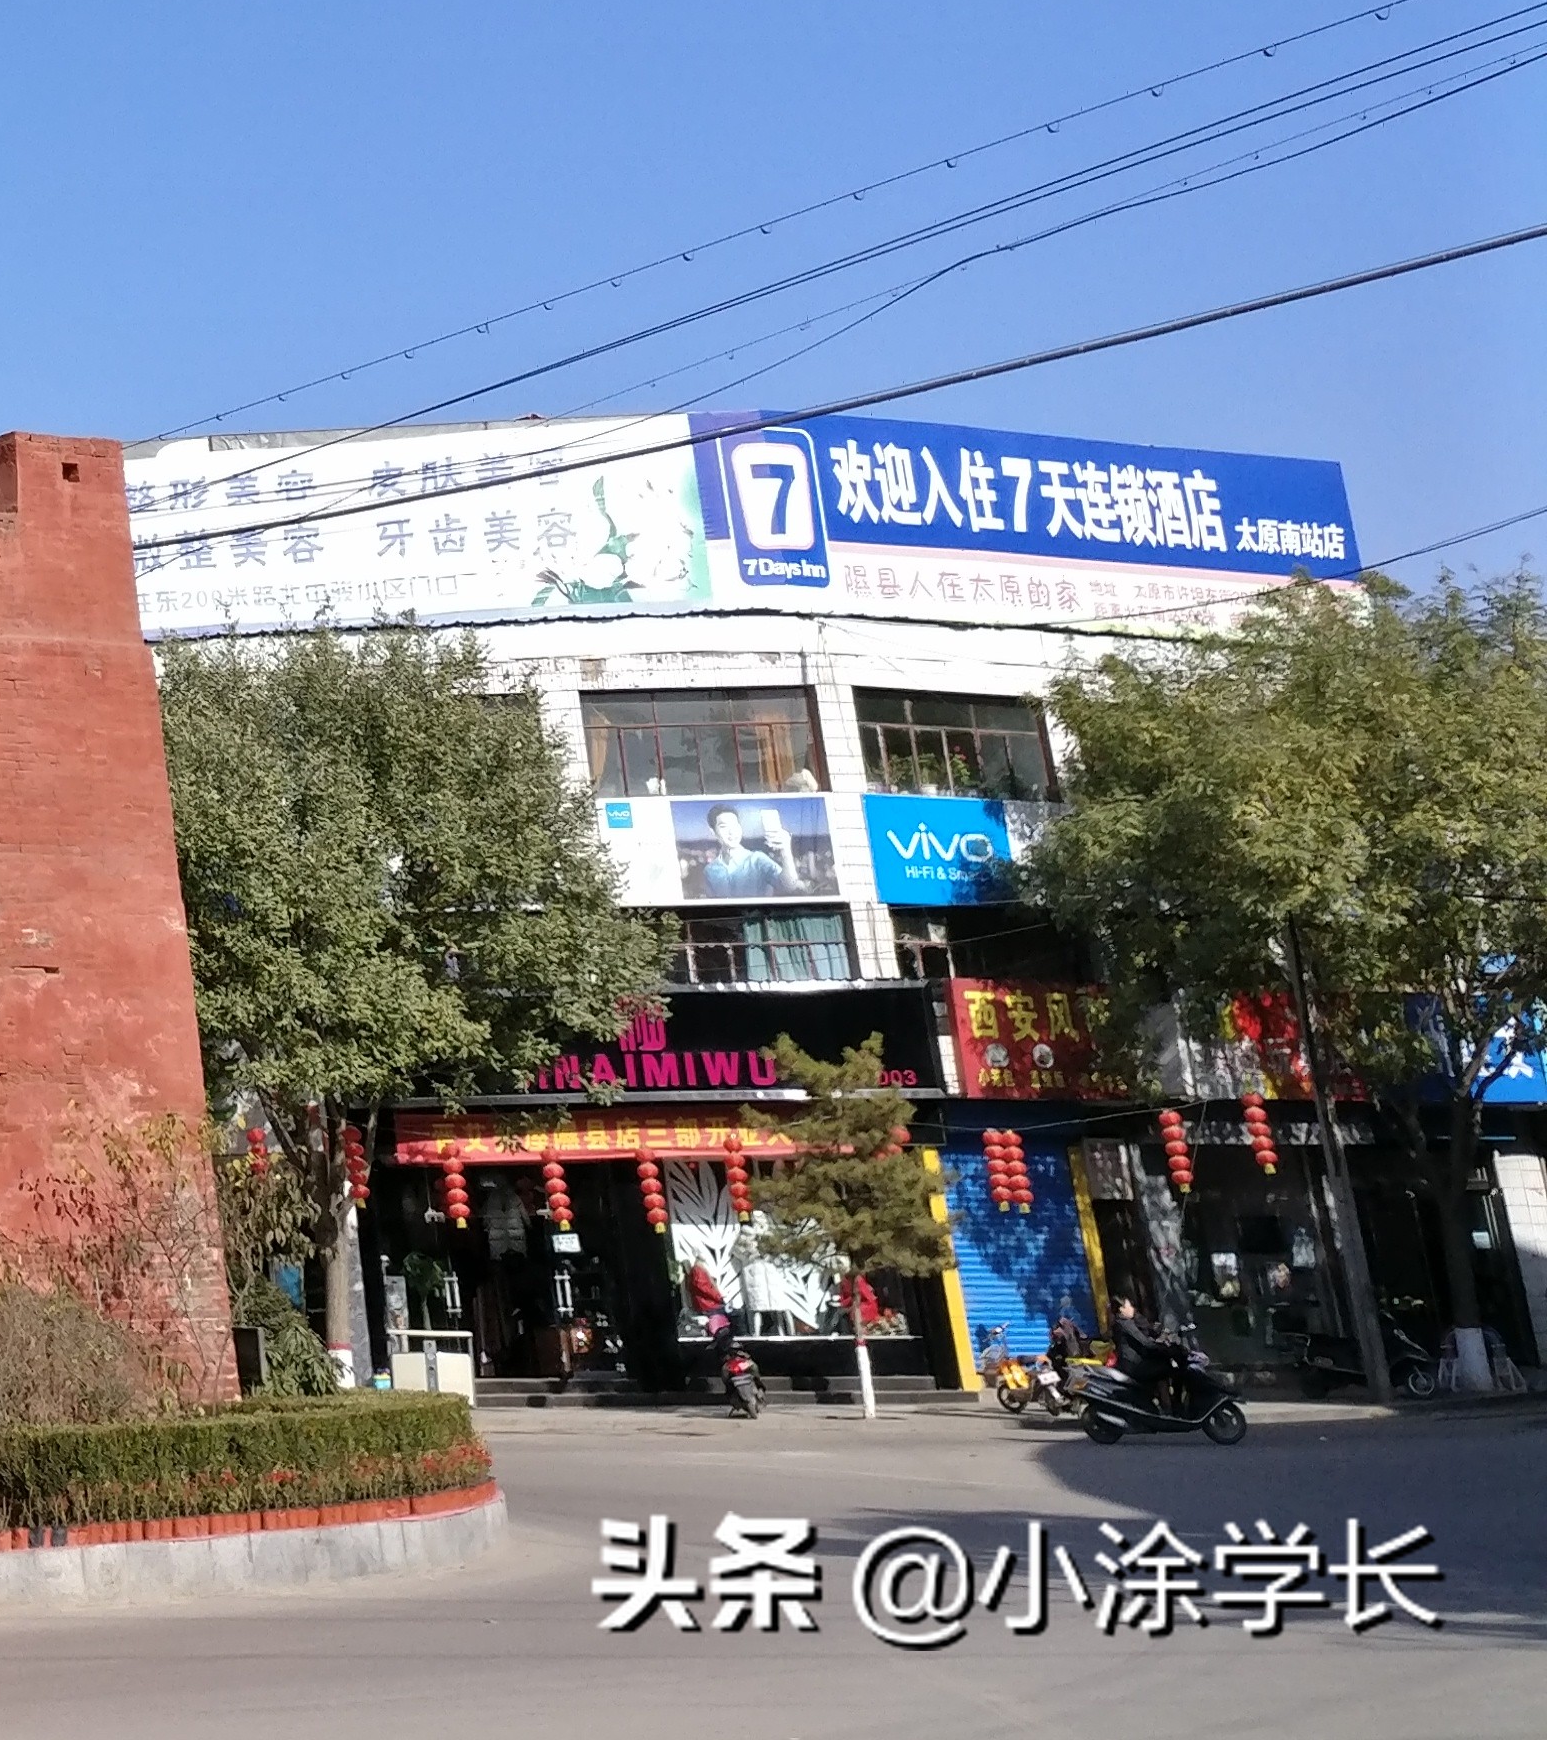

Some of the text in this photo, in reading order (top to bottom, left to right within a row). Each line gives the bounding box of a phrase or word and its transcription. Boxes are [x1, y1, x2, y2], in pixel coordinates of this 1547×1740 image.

[750, 463, 796, 535] 7
[830, 439, 1228, 552] 欢迎入住7天连锁酒店
[377, 508, 577, 558] 牙齿美容
[1235, 517, 1346, 560] 太原南站店
[743, 558, 826, 578] 7 Days Inn
[886, 822, 994, 863] vivo
[936, 866, 947, 881] &
